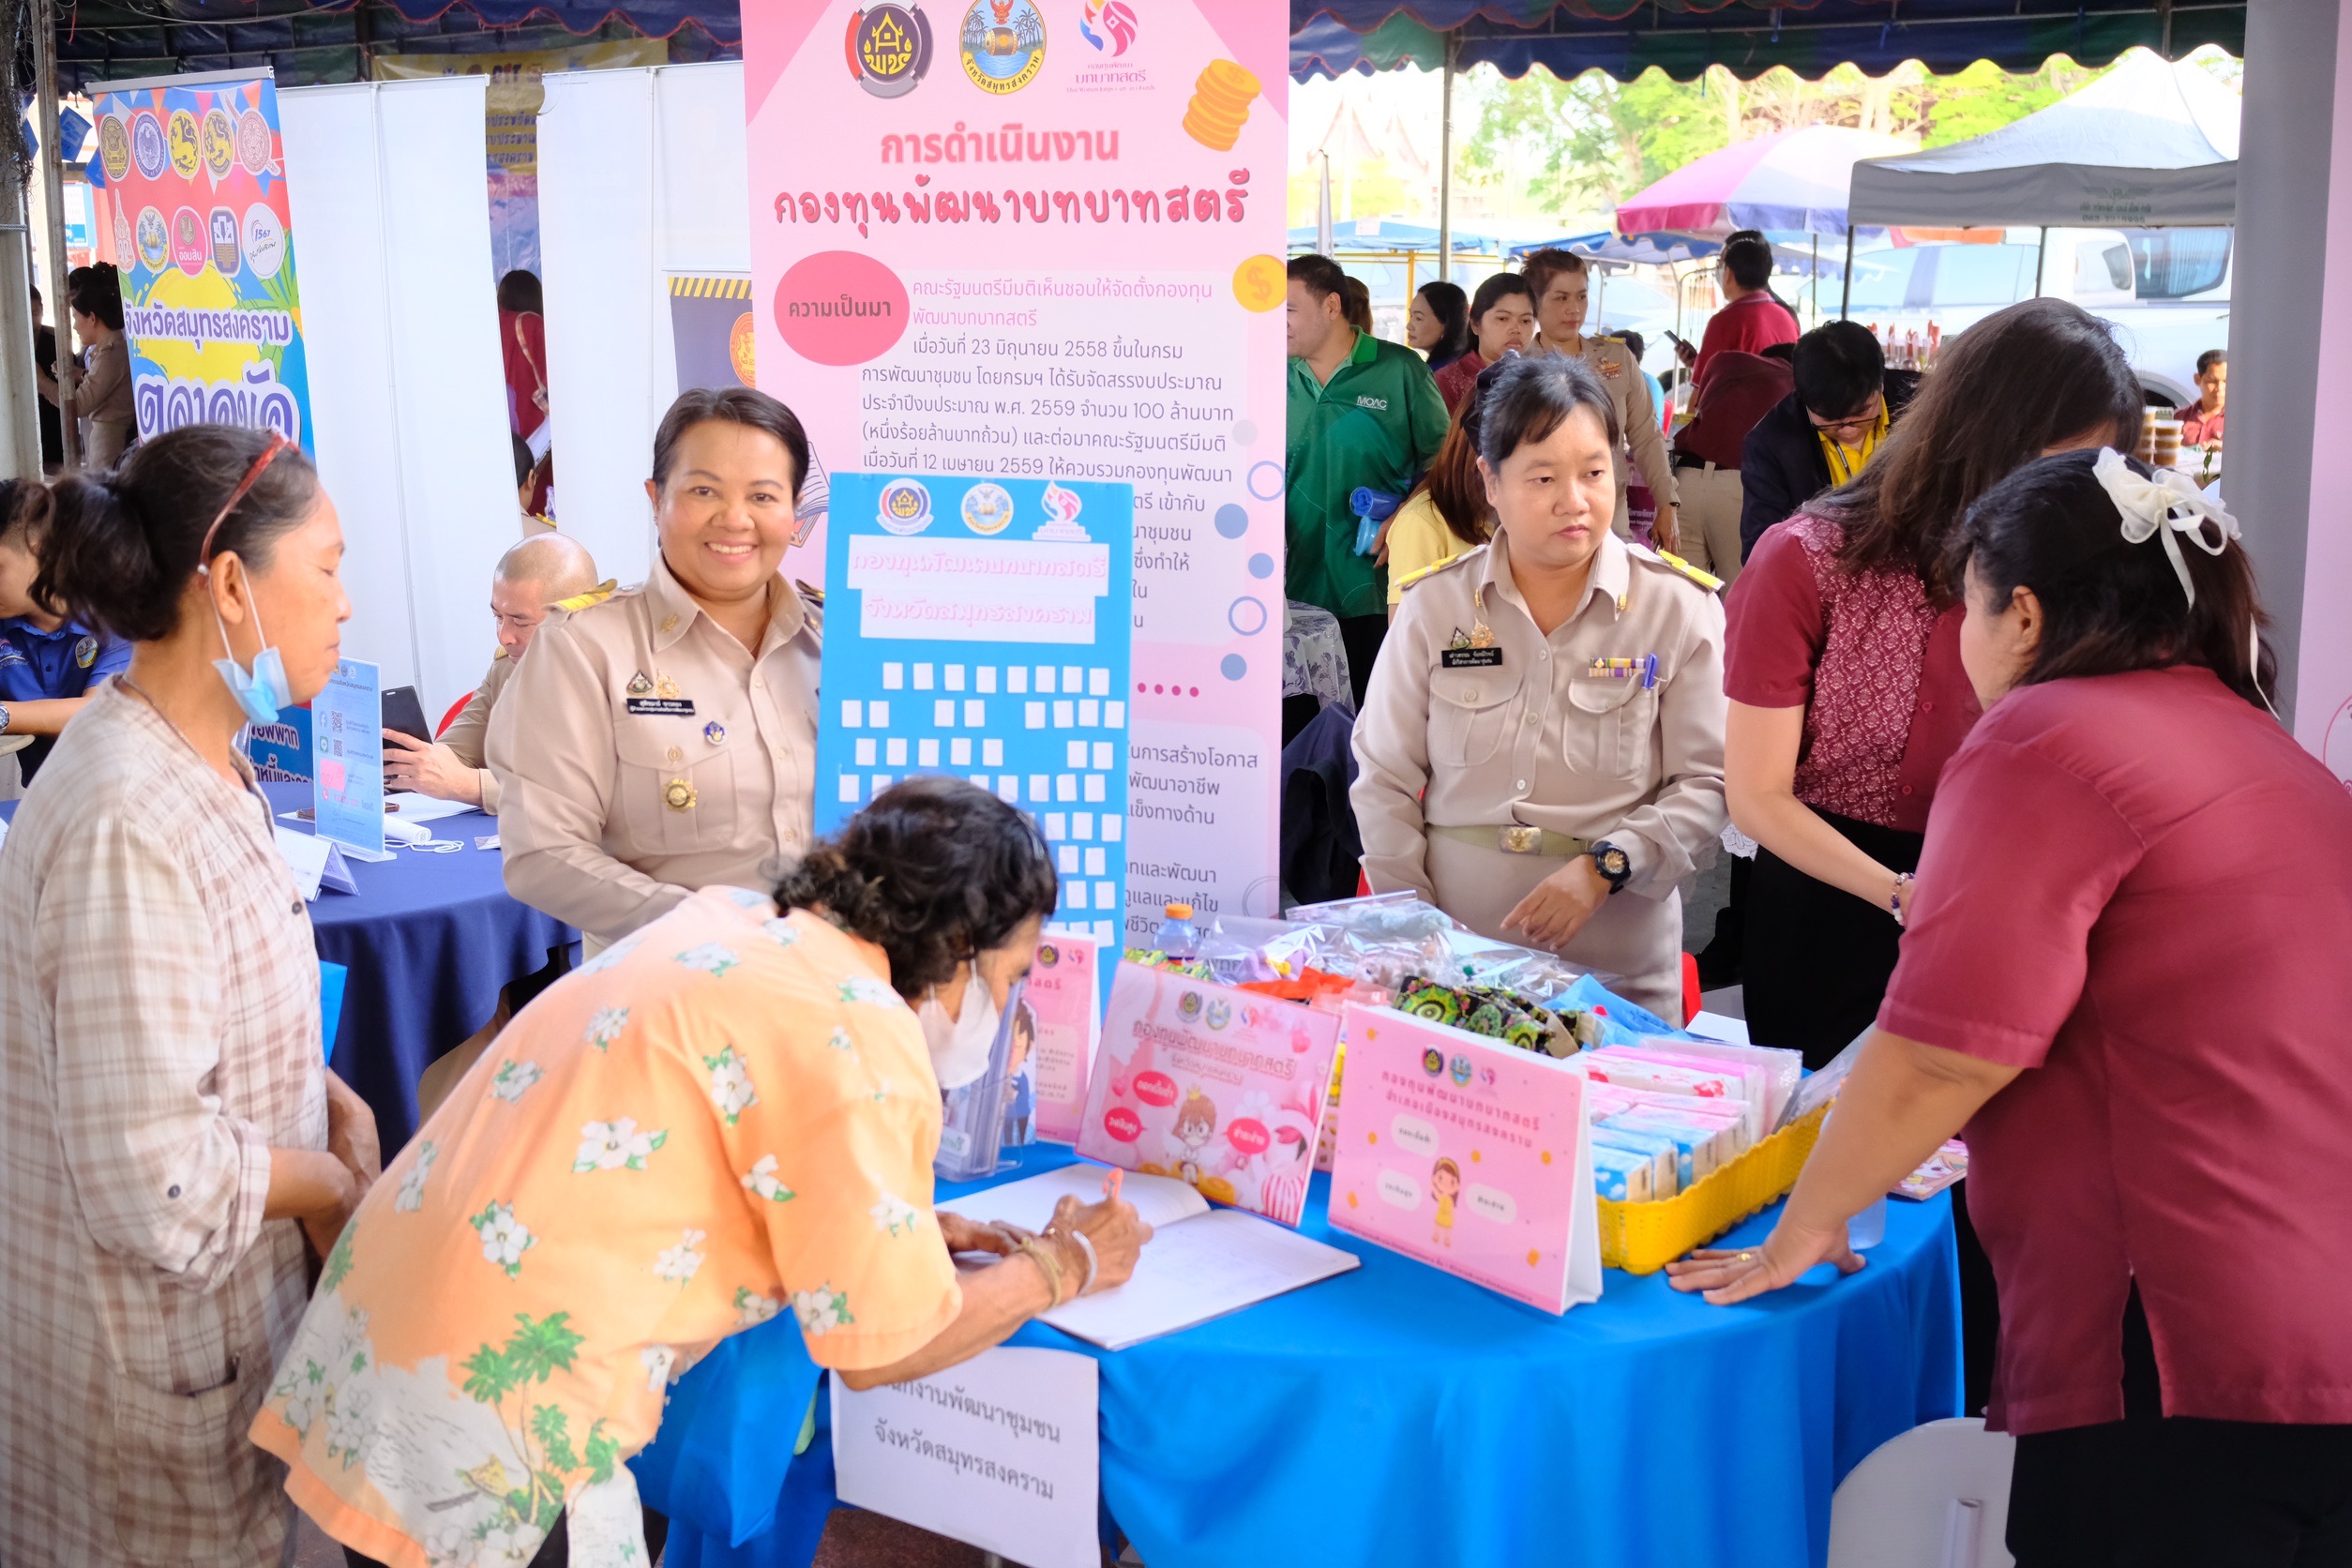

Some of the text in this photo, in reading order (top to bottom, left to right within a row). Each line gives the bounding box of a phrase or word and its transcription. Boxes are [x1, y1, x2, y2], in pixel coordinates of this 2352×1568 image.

[965, 54, 1041, 93] จังหวัดสมุทรสงคราม
[1075, 69, 1147, 83] บทบาทสตรี
[881, 120, 1119, 164] การดำเนินงาน
[774, 167, 1251, 240] กองทุนพัฒนาบทบาทสตรี
[789, 294, 892, 318] ความเป็นมา
[912, 307, 1037, 326] พัฒนาบทบาทสตรี
[125, 302, 289, 349] จังหวัดสมุทรสงคราม
[913, 332, 1183, 361] เมื่อวันที่ 23 มิถุนายน 2558 ขึ้นในกรม
[862, 364, 1222, 391] การพัฒนาชุมชน โดยกรมฯ ได้รับจัดสรรงบประมาณ
[862, 393, 1233, 421] ประจำปีงบประมาณ พ.ศ. 2559 จำนวน 100 ล้านบาท
[862, 417, 1226, 454] (หนึ่งร้อยล้านบาทถ้วน) และต่อมาคณะรัฐมนตรีมีมติ
[864, 445, 1232, 485] เมื่อวันที่ 12 เมษายน 2559 ให้ควบรวมกองทุนพัฒนา
[1159, 490, 1205, 512] เข้ากับ
[852, 551, 1107, 579] กองทุนพัฒนาบทบาทสตรี
[1134, 546, 1189, 571] ซึ่งทำให้
[865, 596, 1093, 626] จังหวัดสมุทรสงคราม
[1128, 771, 1220, 796] พัฒนาอาชีพ
[884, 1379, 1062, 1443] นกงานพัฒนาชุมชน
[874, 1416, 1055, 1500] จังหวัดสมุทรสงคราม
